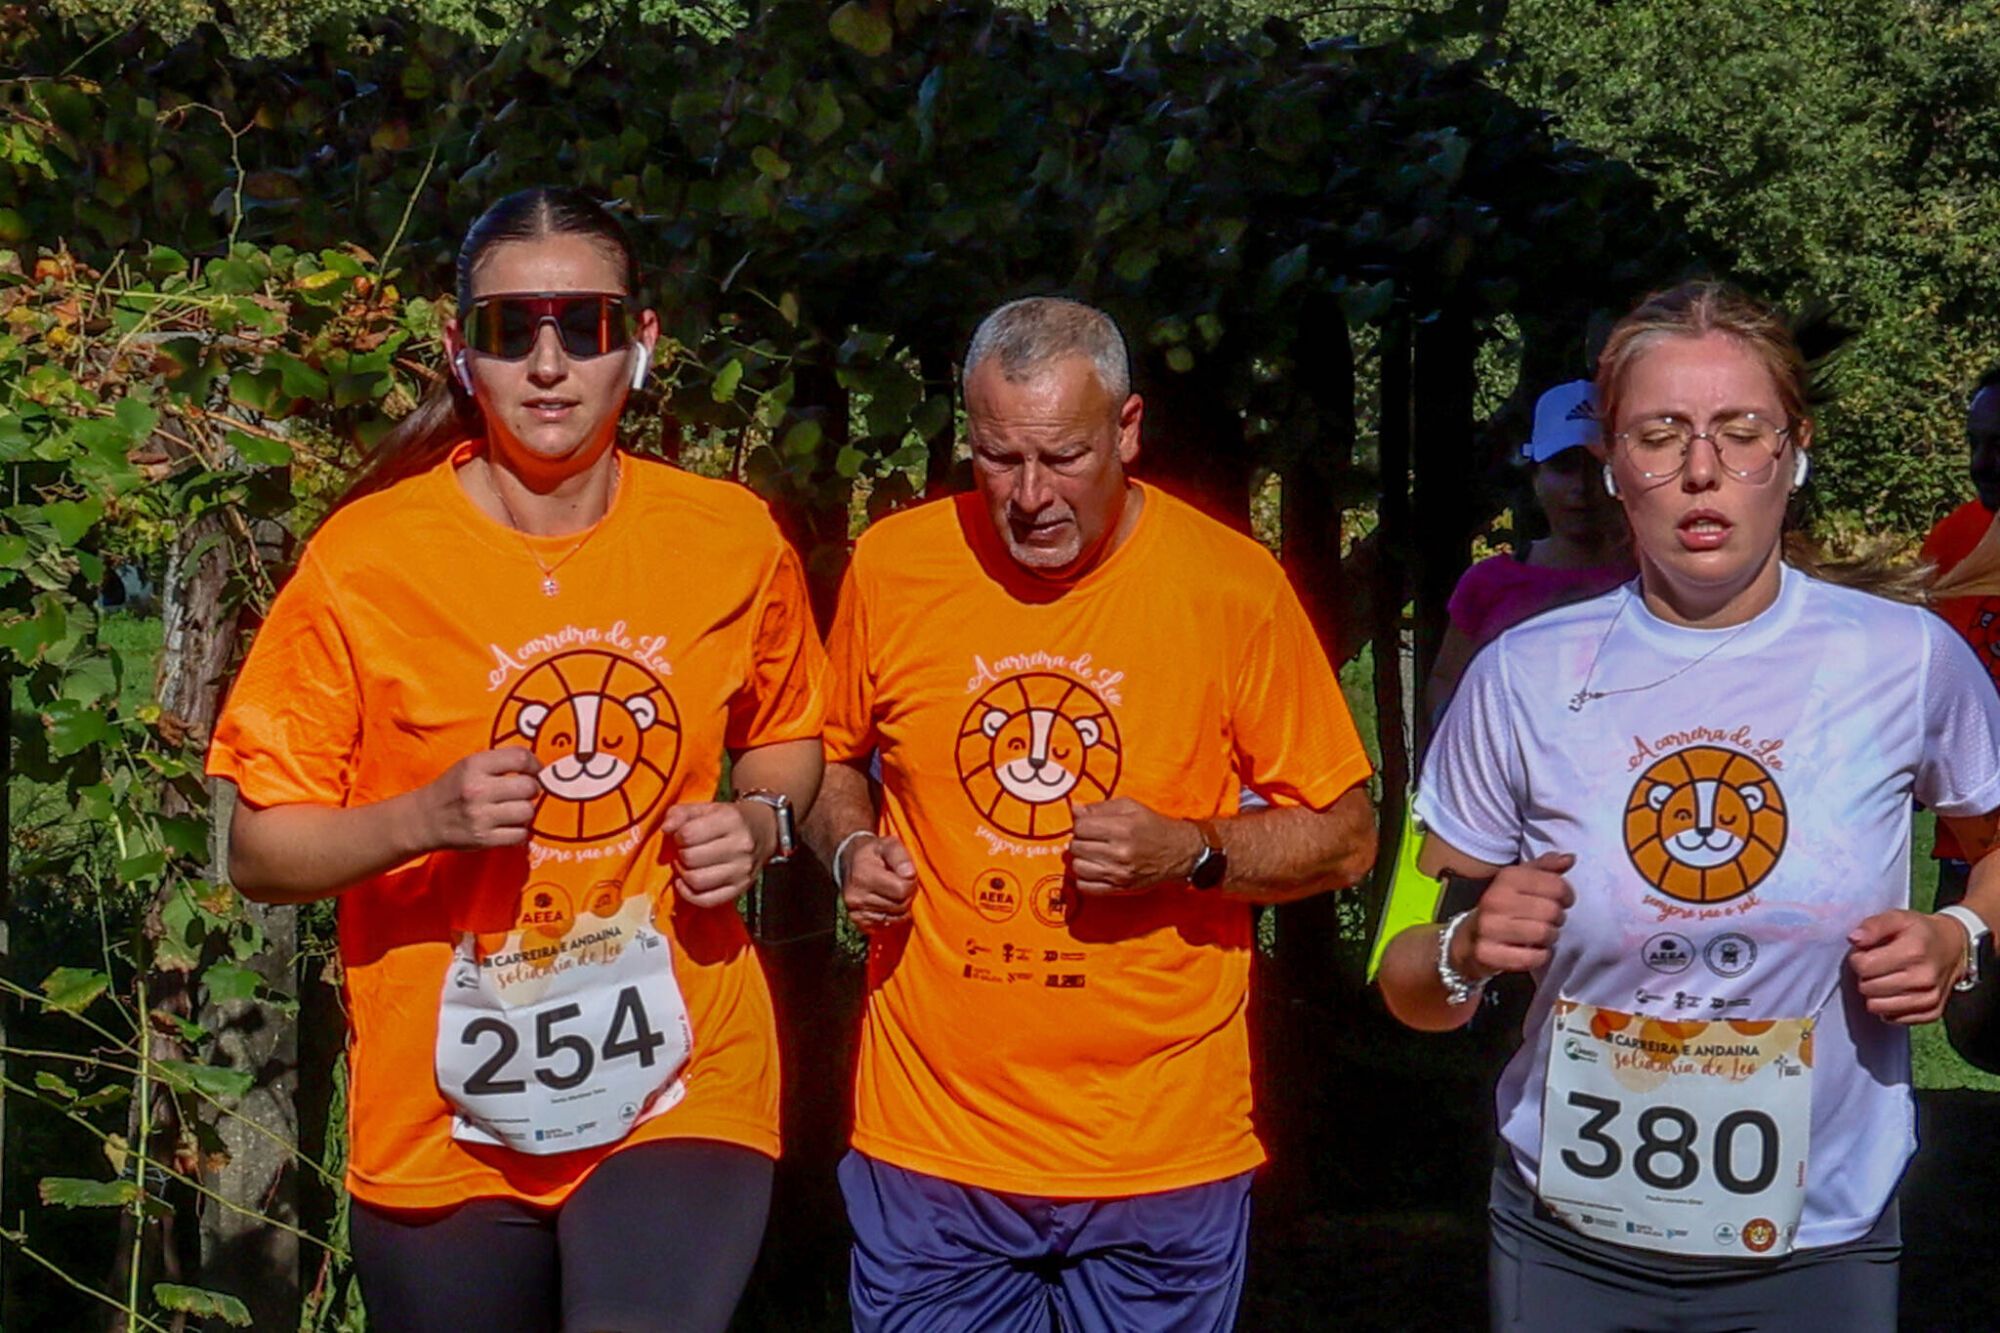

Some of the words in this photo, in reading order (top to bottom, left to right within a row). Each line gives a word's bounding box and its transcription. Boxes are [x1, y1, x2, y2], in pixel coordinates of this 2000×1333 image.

[486, 642, 526, 692] A
[517, 624, 601, 660] carreira
[605, 620, 632, 650] de
[633, 634, 673, 676] Leo
[965, 653, 997, 692] A
[995, 650, 1066, 673] carreira
[1069, 651, 1092, 679] de
[1090, 668, 1124, 707] Leo
[1627, 735, 1659, 772] A
[1655, 725, 1727, 750] carreira
[1729, 725, 1753, 749] de
[1753, 738, 1784, 771] Leo
[575, 848, 601, 862] sae
[617, 826, 642, 856] sol
[976, 824, 1025, 857] sempre
[1026, 844, 1050, 858] sae
[979, 892, 1014, 904] AEEA
[1641, 893, 1694, 922] sempre
[1698, 908, 1722, 920] sae
[1738, 892, 1761, 914] sol
[522, 910, 564, 924] AEEA
[495, 945, 558, 967] CARREIRA
[560, 940, 568, 953] E
[570, 926, 622, 950] ANDAINA
[1649, 951, 1687, 960] AEEA
[497, 959, 573, 989] solidaria
[577, 948, 595, 967] de
[461, 985, 665, 1096] 254
[1615, 1035, 1679, 1055] CARREIRA
[1684, 1046, 1692, 1055] E
[1696, 1046, 1760, 1056] ANDAINA
[1613, 1050, 1697, 1075] solidaria
[1701, 1057, 1726, 1076] de
[1561, 1091, 1779, 1195] 380
